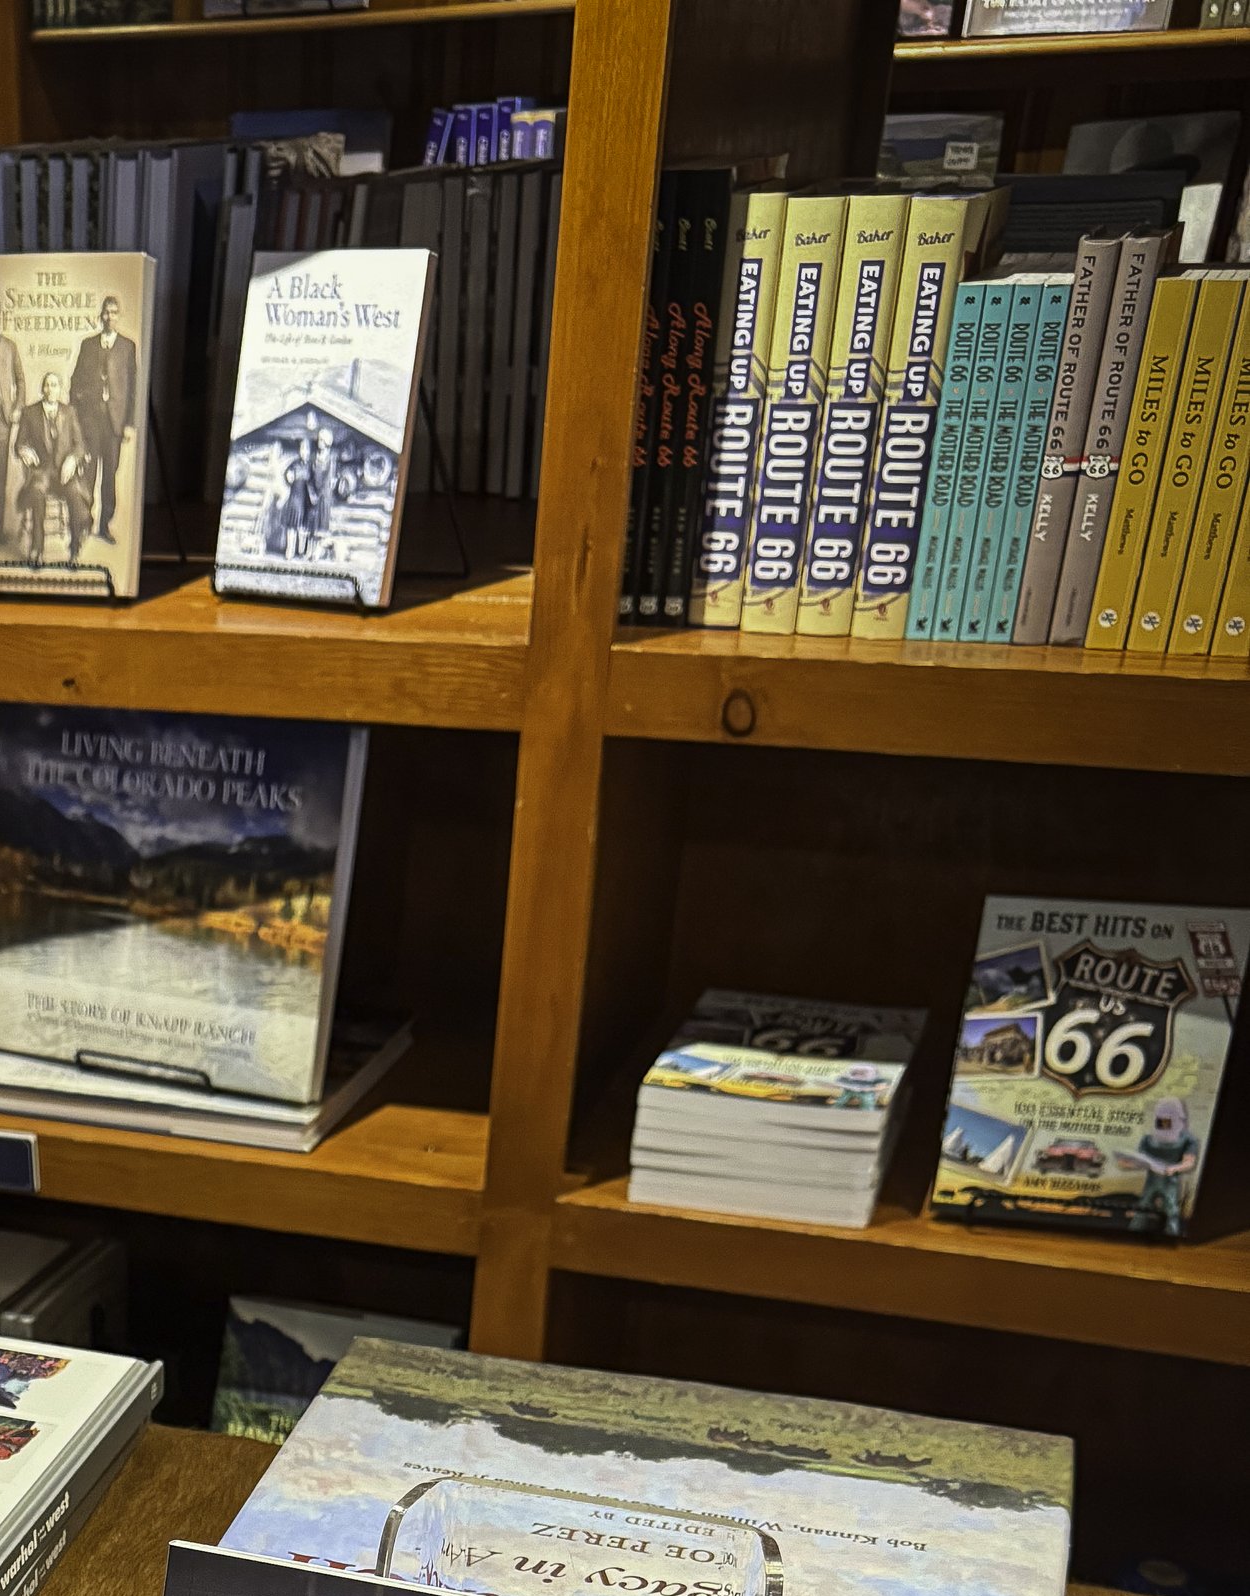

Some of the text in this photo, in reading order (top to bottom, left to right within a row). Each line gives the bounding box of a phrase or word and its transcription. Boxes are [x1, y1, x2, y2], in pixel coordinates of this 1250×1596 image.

[795, 232, 830, 246] Baker
[5, 288, 96, 309] SEMINOLE
[36, 272, 66, 286] THE
[267, 273, 342, 300] A Black
[2, 310, 101, 332] FREEDMEN
[266, 302, 400, 328] Woman's West
[1051, 255, 1096, 449] FATHER OF ROUTE 66
[1097, 253, 1146, 448] FATHER OF ROUTE 66
[657, 302, 686, 468] Along Route 66
[683, 302, 712, 468] Along Route 66
[701, 262, 758, 573] EATING UP ROUTE 66
[754, 267, 818, 580] EATING UP ROUTE 66
[811, 265, 879, 580] EATING UP ROUTE 66
[867, 267, 940, 585] EATING UP ROUTE 66
[932, 322, 975, 506] ROUTE 66 THE MOTHER ROAD
[958, 323, 1001, 507] ROUTE 66 THE MOTHER ROAD
[985, 323, 1030, 508] ROUTE 66 THE MOTHER ROAD
[1225, 433, 1240, 449] to
[1043, 464, 1060, 475] 66
[1089, 464, 1106, 475] 66
[1216, 456, 1236, 489] GO
[1035, 493, 1052, 542] KELLY
[1080, 493, 1098, 541] KELLY
[61, 729, 266, 776] LIVING BENEATH
[28, 752, 302, 811] THE COLORADO PEAKS
[997, 912, 1174, 939] THE BEST HITS ON
[1073, 954, 1176, 999] ROUTE
[1100, 993, 1126, 1016] US
[1045, 1009, 1155, 1089] 66
[0, 1491, 70, 1590] warhol west
[531, 1521, 652, 1555] PEREZ
[588, 1510, 715, 1537] EDITED BY
[45, 1529, 67, 1569] west
[513, 1556, 566, 1583] in
[900, 1541, 928, 1553] Bob
